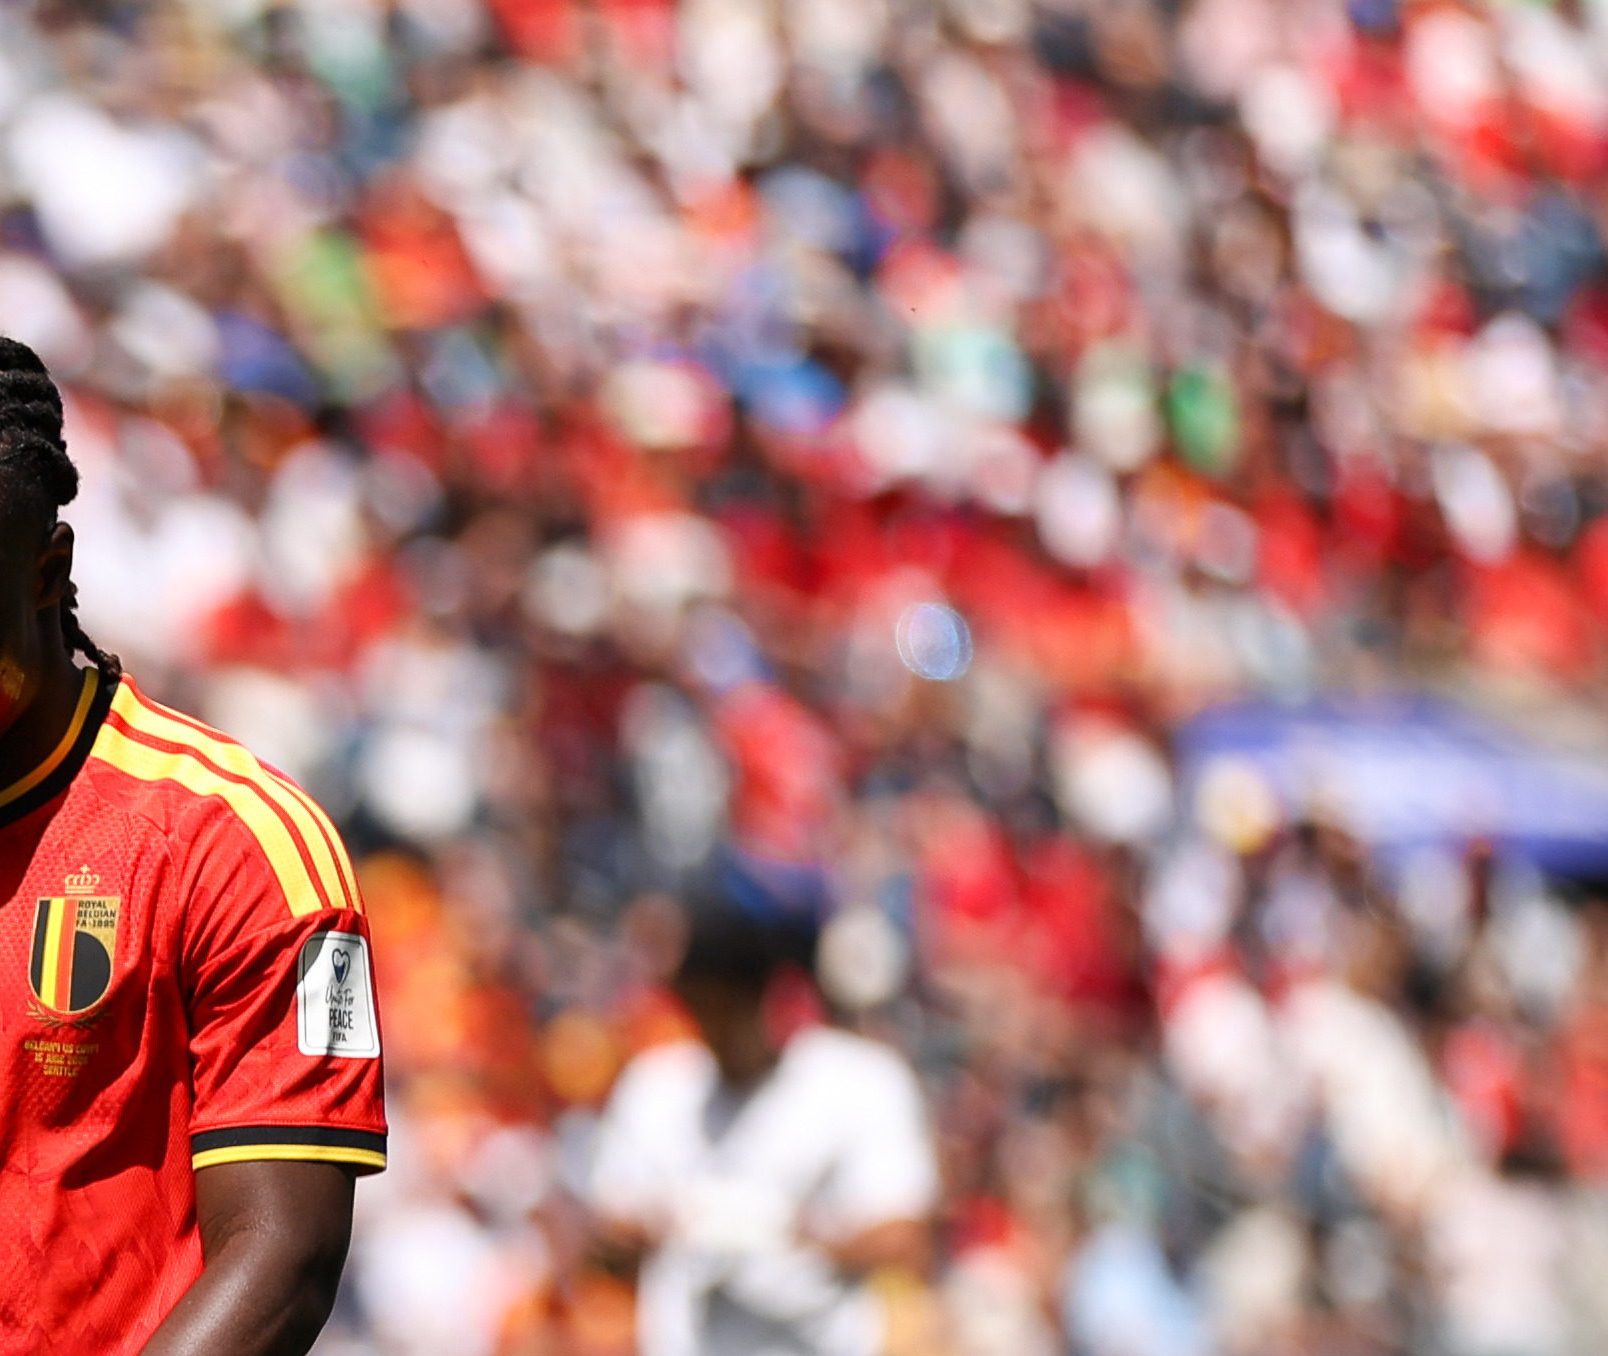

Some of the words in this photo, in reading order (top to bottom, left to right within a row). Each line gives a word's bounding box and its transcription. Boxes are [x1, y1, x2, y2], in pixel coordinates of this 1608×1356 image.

[78, 900, 107, 909] ROYAL
[77, 909, 116, 918] BELGIAN
[329, 1008, 354, 1030] PEACE
[332, 1032, 347, 1043] FIFA
